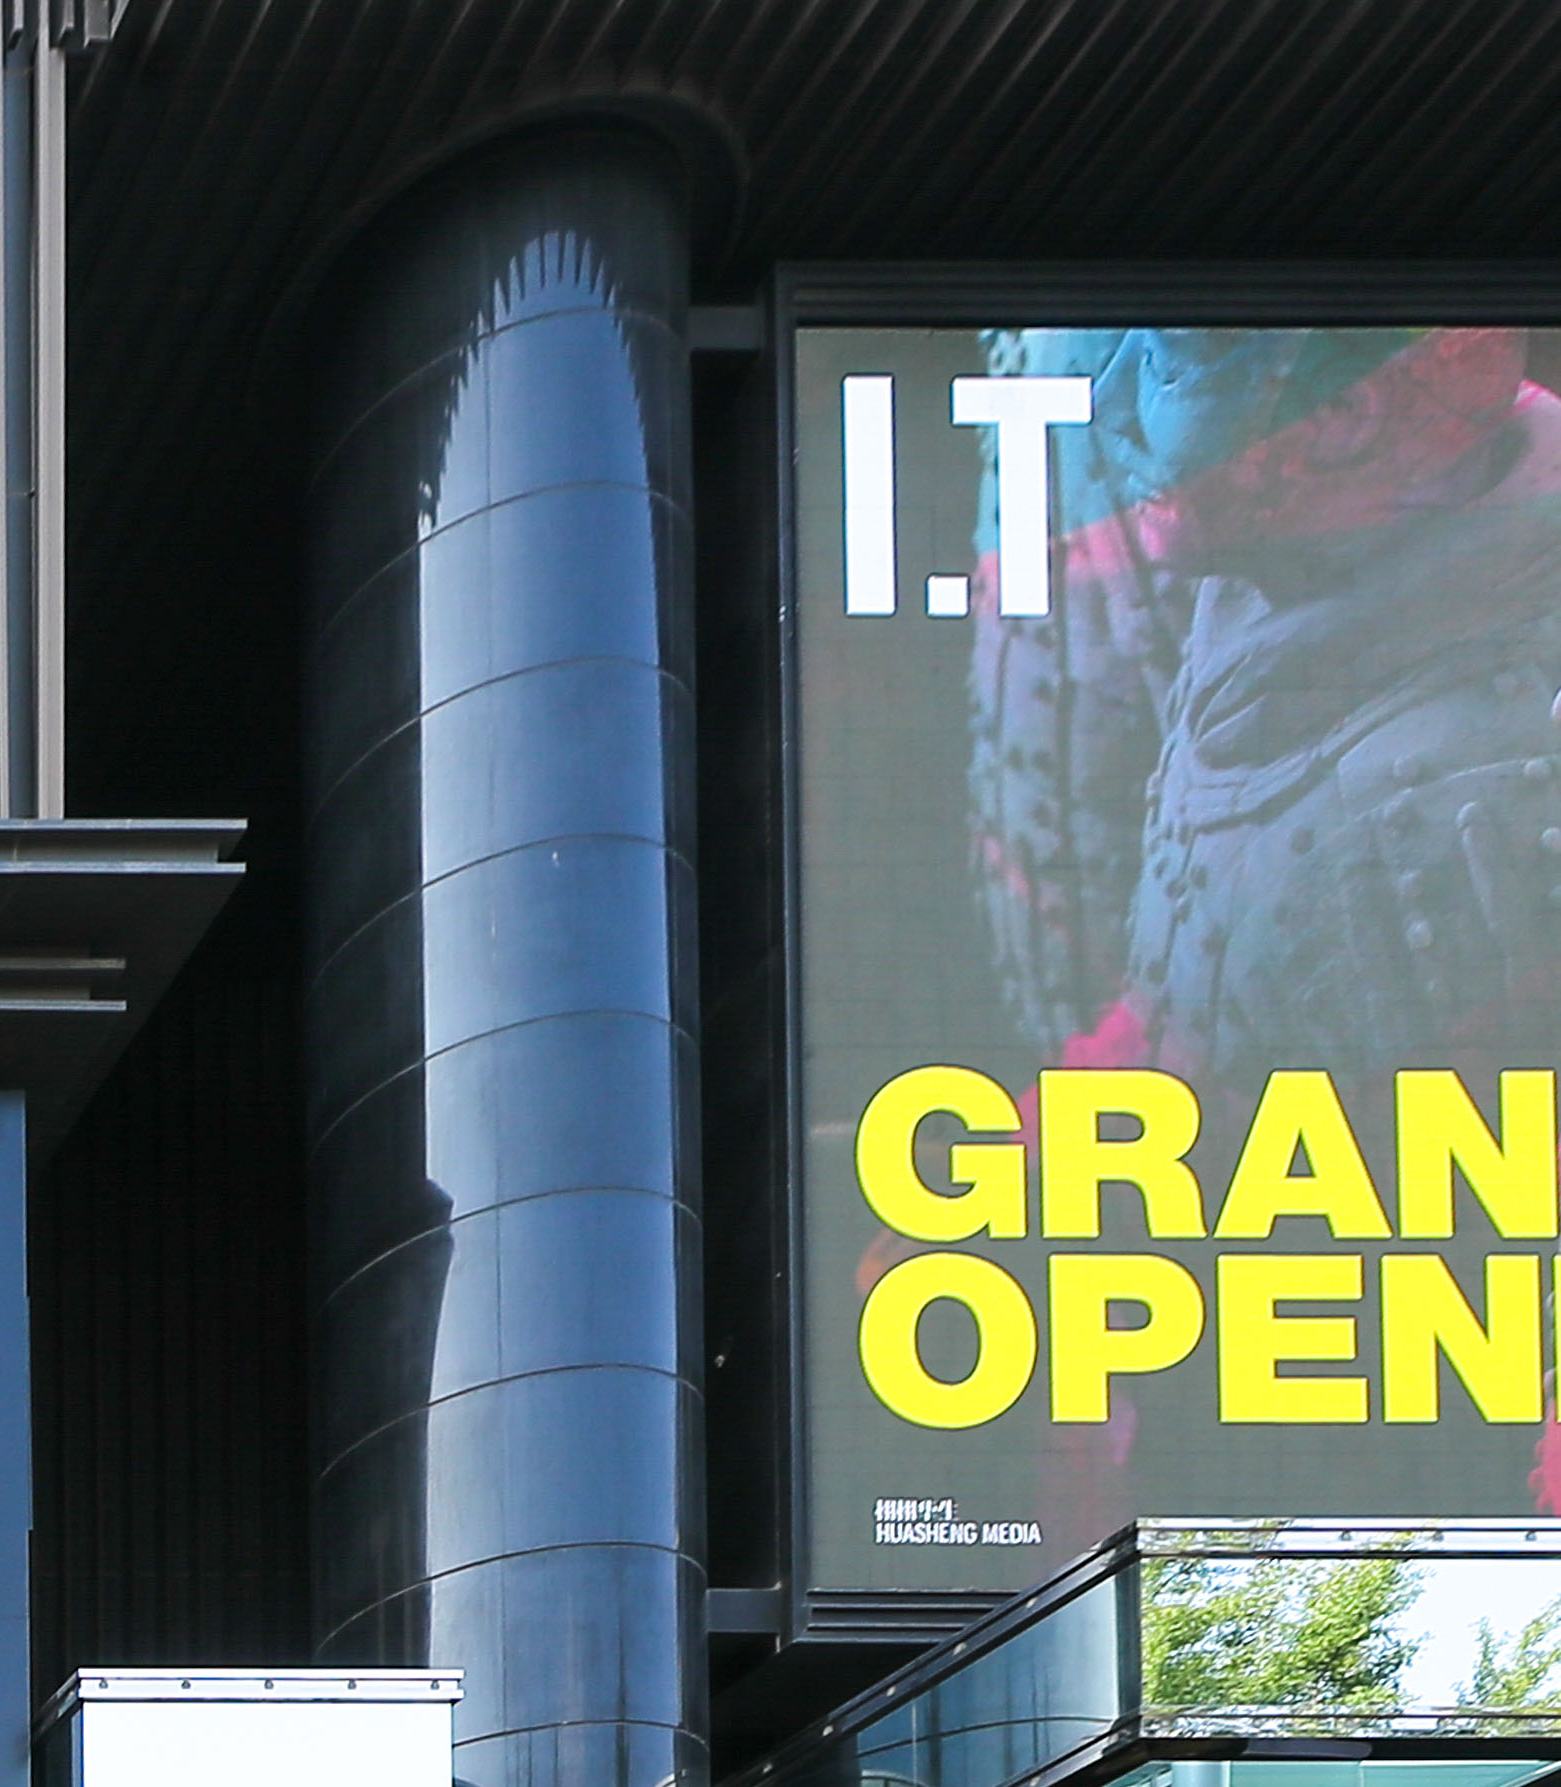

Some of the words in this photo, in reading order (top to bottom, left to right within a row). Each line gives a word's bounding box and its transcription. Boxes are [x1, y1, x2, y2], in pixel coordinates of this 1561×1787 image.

[844, 375, 1093, 616] I.T
[856, 1065, 1559, 1242] GRAN
[859, 1252, 1561, 1430] OPEN
[876, 1523, 978, 1544] HUASHENG
[981, 1523, 1041, 1544] MEDIA
